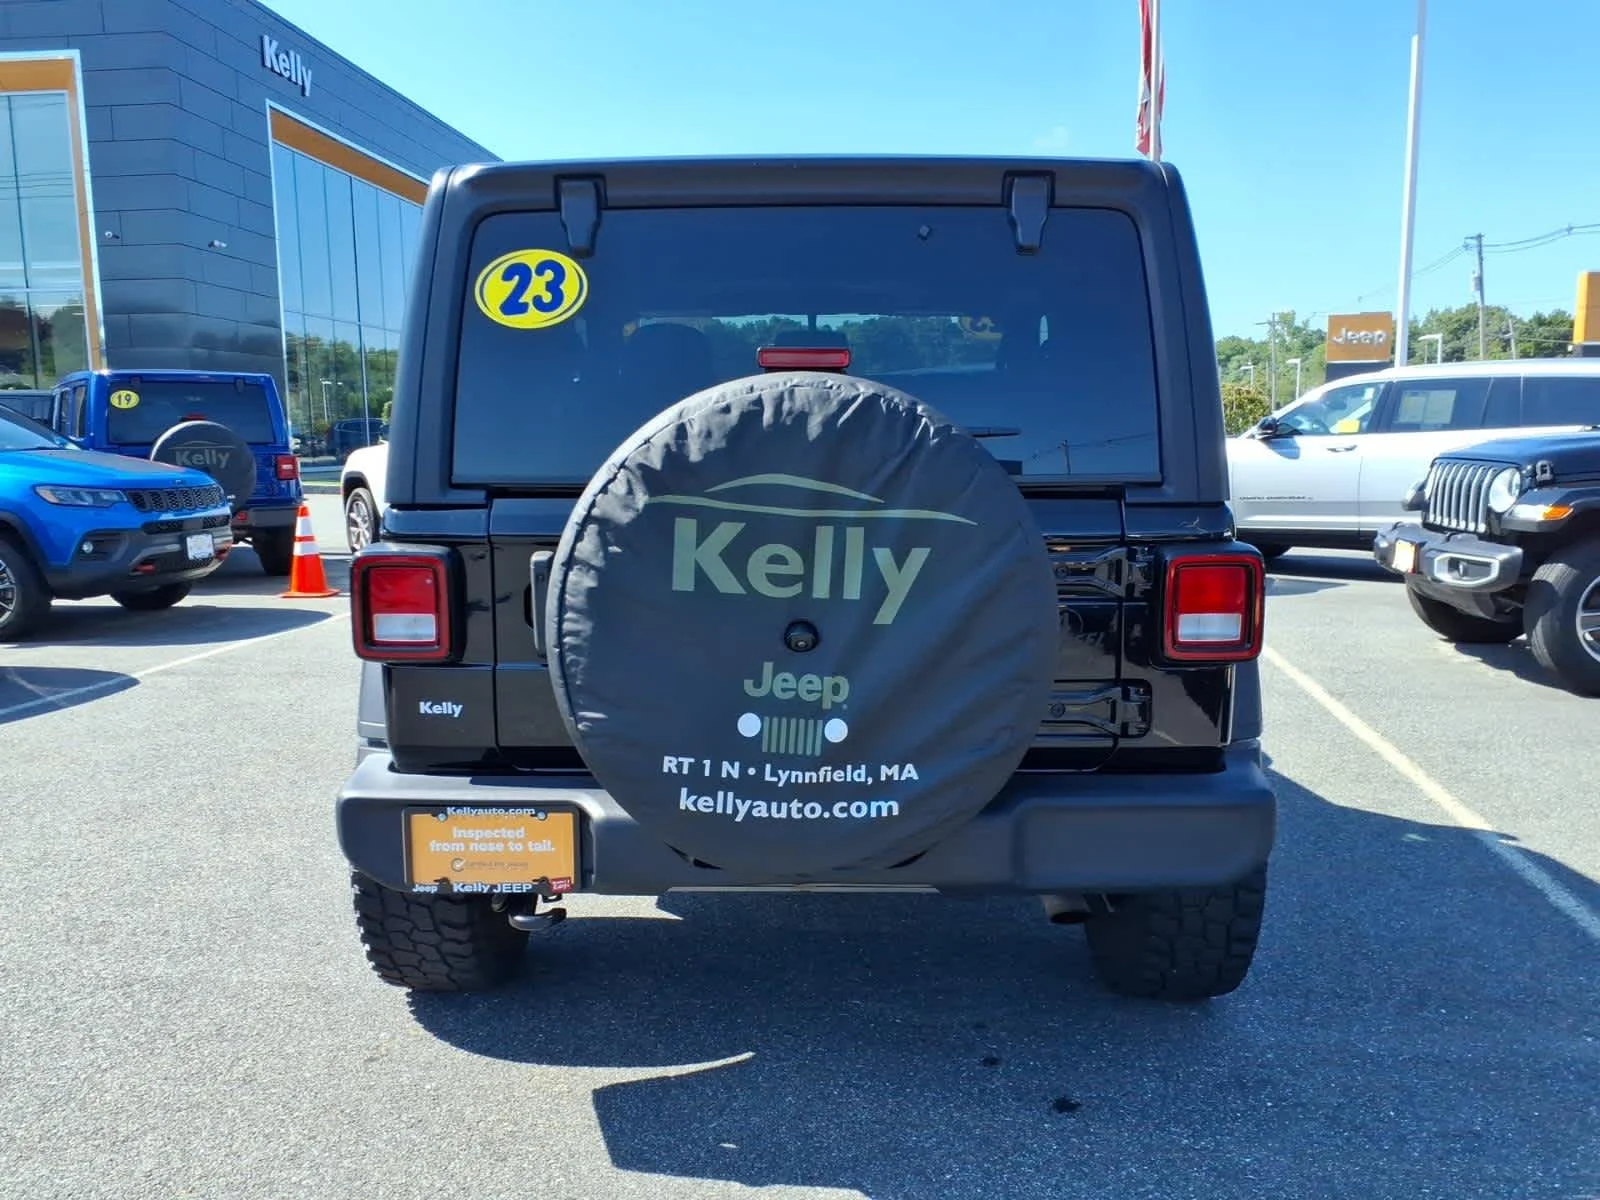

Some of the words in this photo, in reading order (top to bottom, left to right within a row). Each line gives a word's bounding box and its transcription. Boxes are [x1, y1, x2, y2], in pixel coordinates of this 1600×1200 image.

[261, 34, 312, 97] Kelly
[500, 258, 565, 316] 23
[1332, 326, 1389, 346] Jeep
[116, 393, 133, 406] 19
[175, 449, 230, 469] Kelly
[672, 517, 931, 625] Kelly
[743, 662, 849, 709] Jeep
[419, 701, 463, 718] Kelly
[662, 756, 695, 774] RT
[702, 759, 711, 777] 1
[721, 762, 739, 779] N
[764, 763, 873, 787] Lynnfield,
[880, 764, 919, 781] MA
[446, 806, 536, 817] Kellyauto.com
[679, 788, 900, 822] kellyauto.com
[452, 827, 525, 840] Inspected
[430, 840, 465, 852] from
[470, 842, 504, 852] nose
[508, 841, 524, 852] to
[528, 840, 556, 852] tail.
[412, 883, 438, 894] Jeep
[453, 882, 490, 894] Kelly
[493, 883, 533, 893] JEEP
